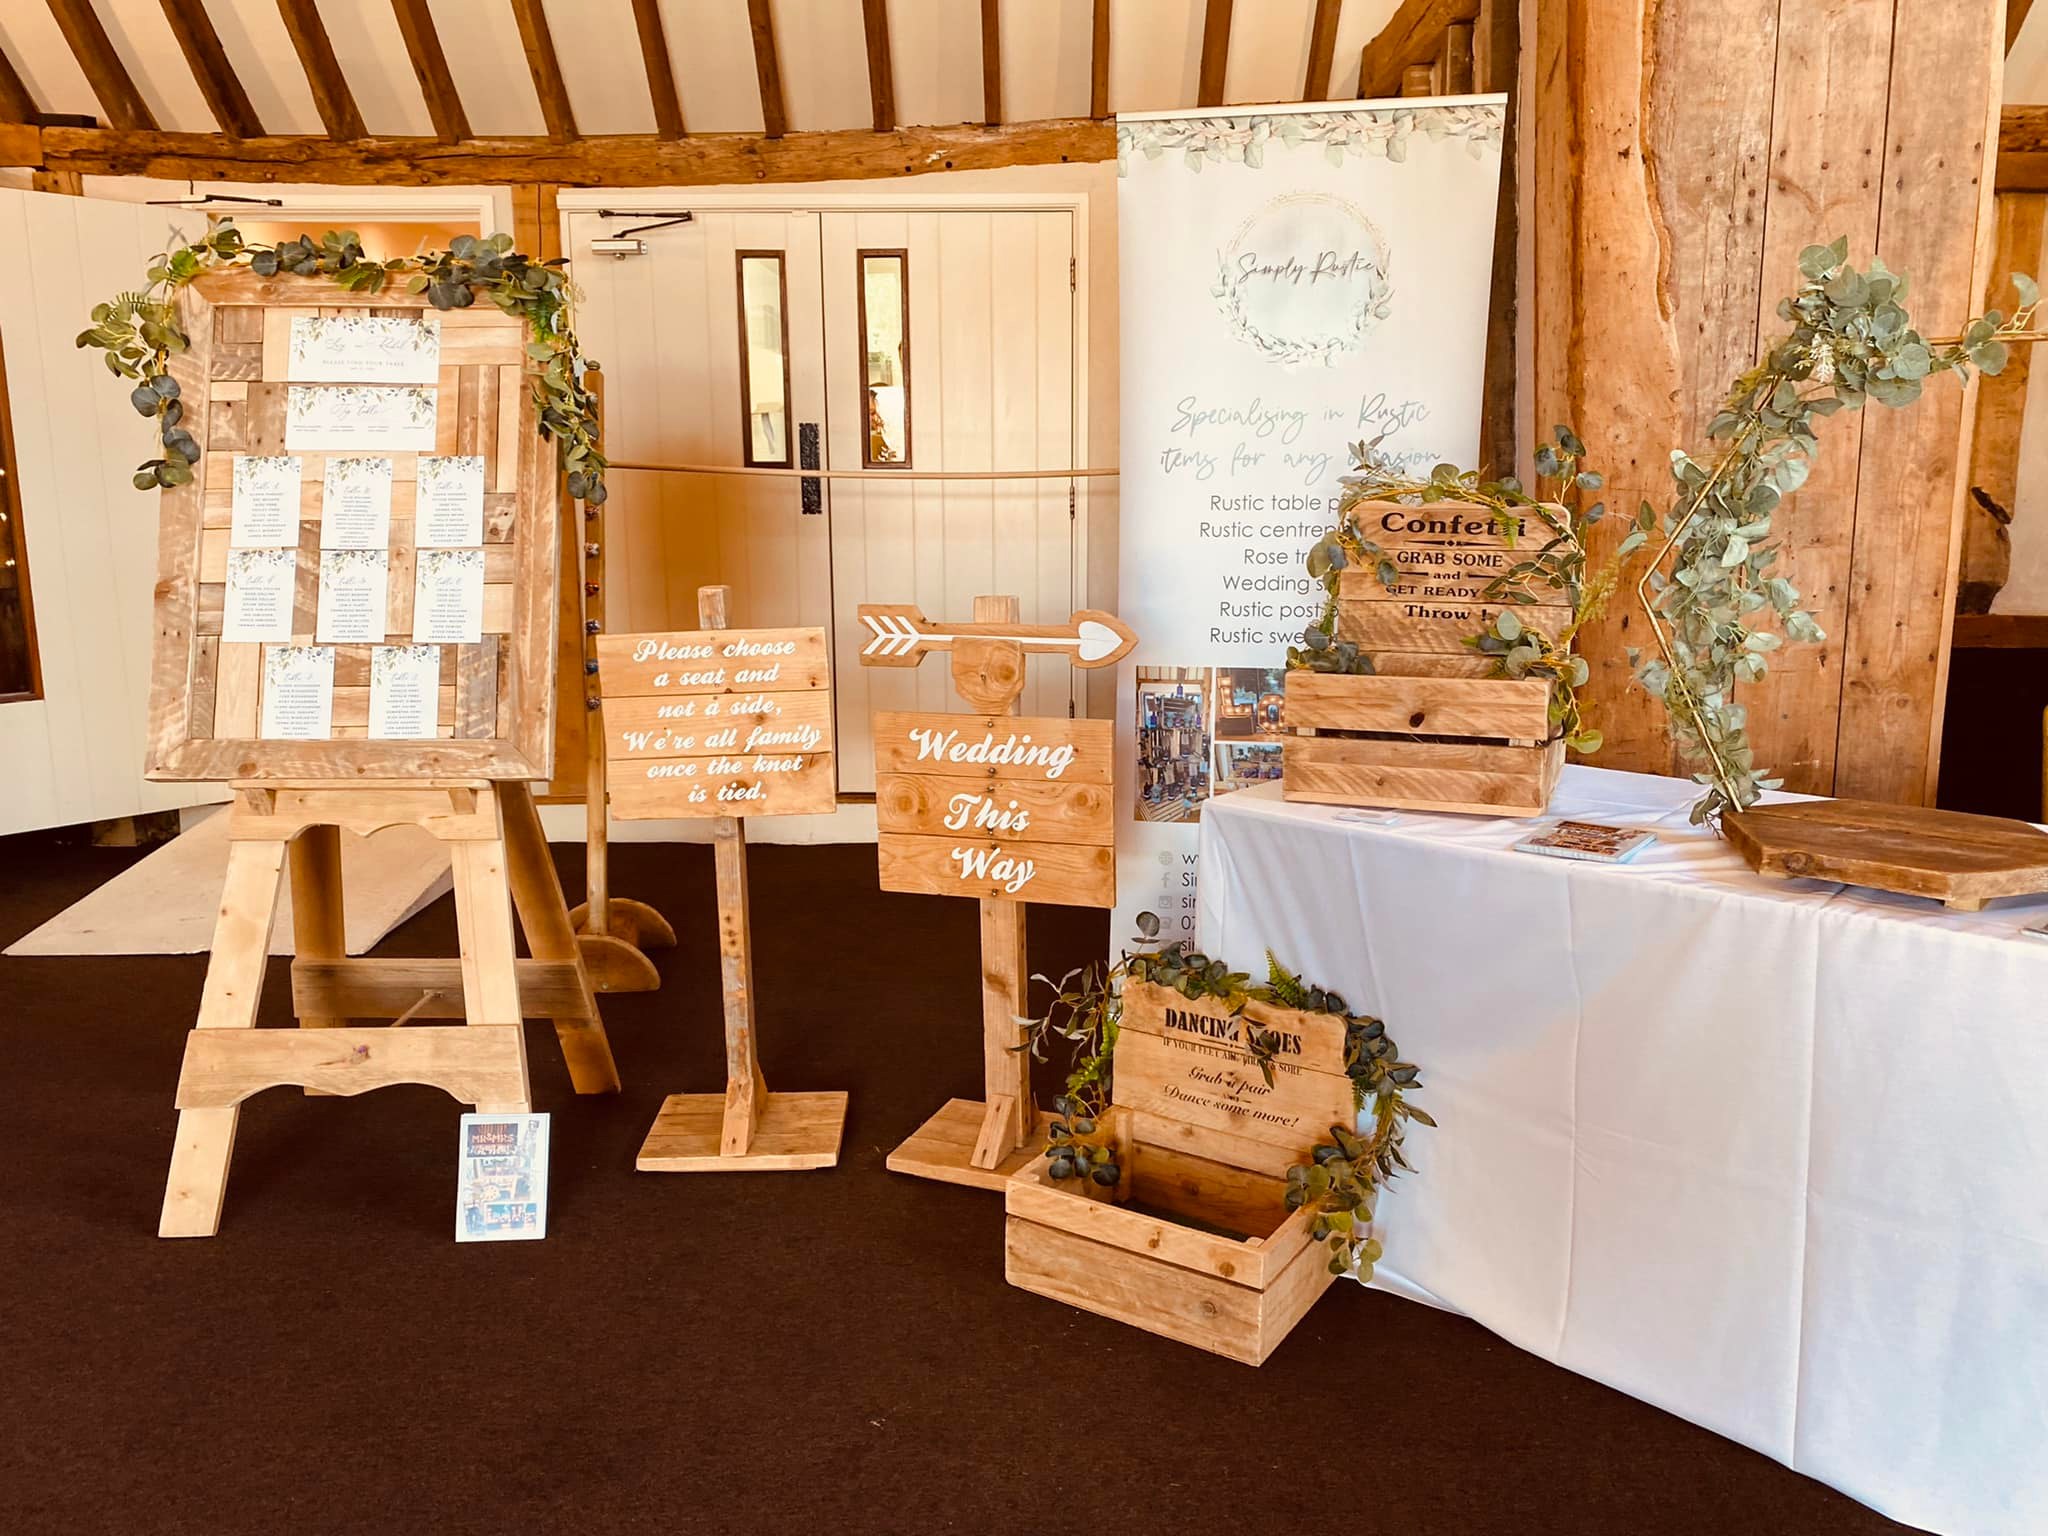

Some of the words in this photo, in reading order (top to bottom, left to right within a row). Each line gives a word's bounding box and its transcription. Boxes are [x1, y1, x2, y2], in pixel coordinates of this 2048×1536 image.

[1238, 252, 1306, 284] Simply
[1310, 250, 1377, 284] Rustic
[1170, 395, 1309, 445] Specialising
[1323, 406, 1345, 422] in
[1357, 392, 1432, 437] Rustic
[1160, 446, 1217, 482] items
[1231, 441, 1265, 478] for
[1283, 452, 1333, 487] any
[1210, 494, 1265, 511] Rustic
[1272, 494, 1322, 511] table
[1200, 521, 1254, 538] Rustic
[1381, 512, 1527, 537] Confeti
[1244, 548, 1289, 565] Rose
[1397, 550, 1446, 565] GRAB
[1452, 553, 1503, 568] SOME
[1223, 575, 1310, 595] Wedding
[1433, 571, 1461, 580] and
[1385, 584, 1418, 596] GET
[1423, 586, 1481, 598] READY
[1219, 600, 1273, 618] Rustic
[1280, 602, 1323, 620] post
[1404, 604, 1471, 621] Throw
[1210, 627, 1263, 644] Rustic
[632, 639, 714, 663] Please
[723, 638, 796, 658] choose
[654, 672, 670, 687] a
[679, 667, 726, 686] seat
[734, 663, 780, 683] and
[657, 701, 696, 718] not
[704, 701, 720, 716] a
[730, 695, 783, 716] side,
[622, 729, 696, 752] We're
[704, 727, 738, 748] all
[743, 725, 822, 753] family
[908, 728, 1076, 779] Wedding
[646, 762, 697, 779] once
[707, 756, 743, 775] the
[751, 754, 803, 773] knot
[687, 783, 707, 803] is
[716, 781, 768, 801] tied.
[943, 793, 1030, 832] This
[951, 847, 1036, 894] Way
[1235, 1080, 1271, 1095] pair
[1164, 1083, 1211, 1106] Dance
[1212, 1101, 1250, 1116] some
[1252, 1110, 1300, 1128] more!
